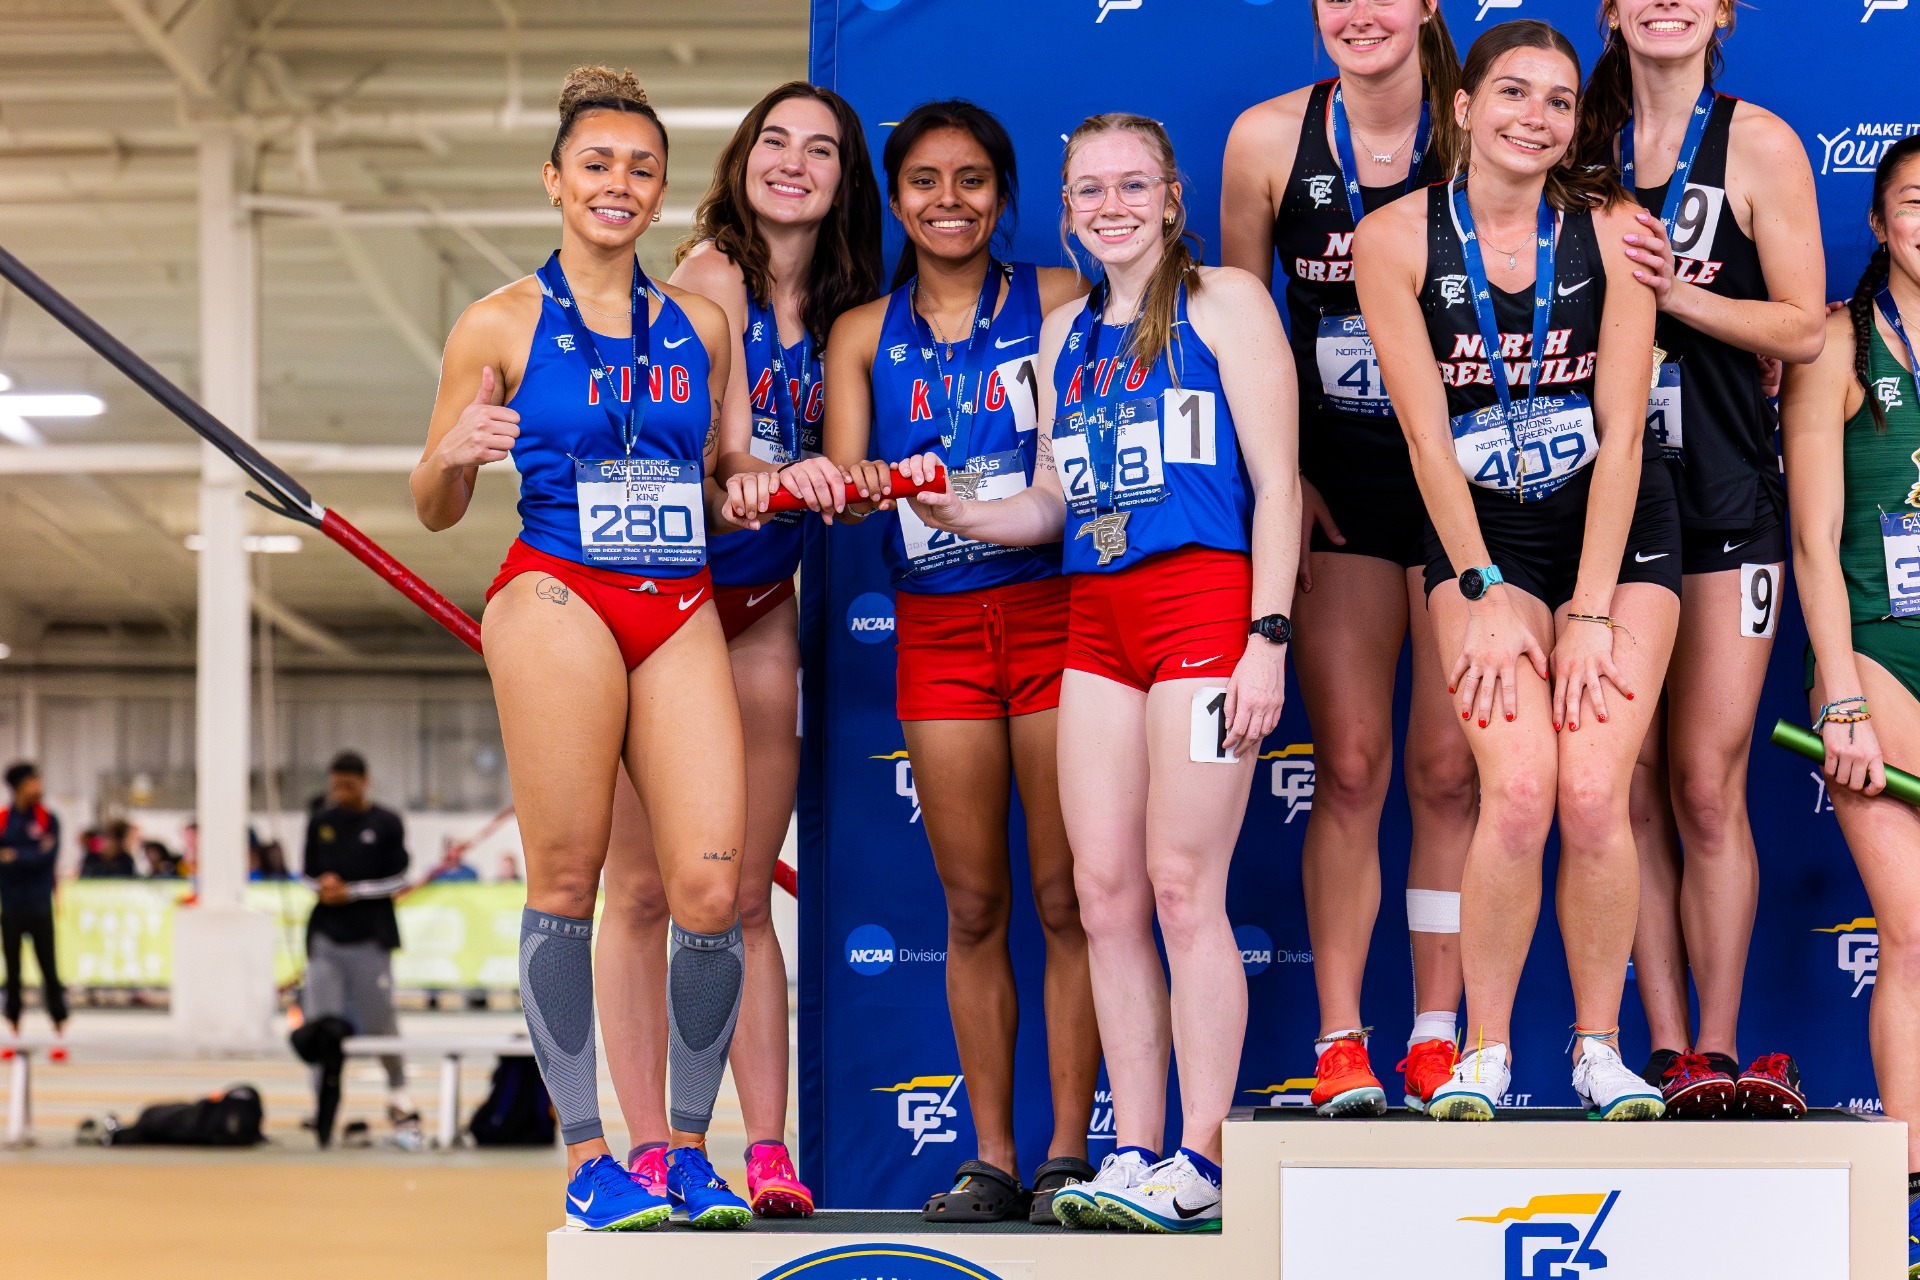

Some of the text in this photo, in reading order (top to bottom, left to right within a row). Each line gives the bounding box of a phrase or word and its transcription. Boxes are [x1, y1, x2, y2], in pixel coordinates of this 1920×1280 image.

[1856, 123, 1920, 136] MAKE IT
[1671, 188, 1709, 253] 9
[1335, 348, 1372, 356] NORTH
[1449, 328, 1572, 359] NRH
[1437, 352, 1597, 387] REENILLE
[750, 368, 824, 423] KNG
[1016, 359, 1038, 424] 1
[1178, 394, 1201, 460] 1
[1476, 398, 1565, 427] CAROLNAS
[1502, 417, 1552, 436] TMMONS
[1475, 437, 1513, 451] NORTH
[1517, 419, 1583, 442] GREENVILLE
[1064, 446, 1149, 497] 28
[1474, 432, 1587, 488] 409
[631, 483, 666, 492] OWERY
[636, 493, 659, 502] KING
[1540, 480, 1555, 489] FIELD
[590, 505, 693, 543] 280
[1751, 568, 1772, 634] 9
[851, 618, 895, 630] NCAA
[1206, 692, 1228, 758] 1
[850, 949, 894, 962] NCAA
[1239, 950, 1271, 964] CAA
